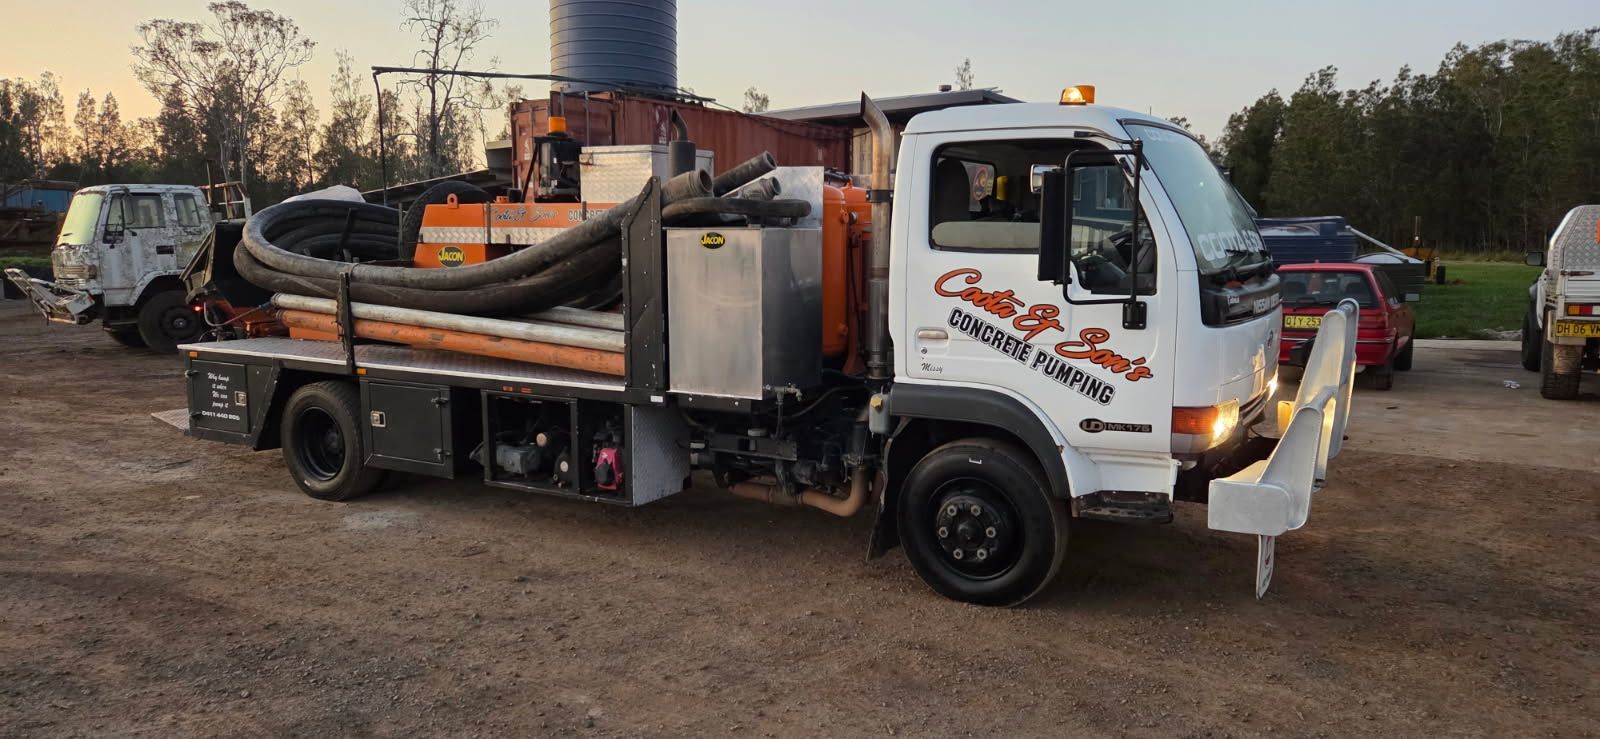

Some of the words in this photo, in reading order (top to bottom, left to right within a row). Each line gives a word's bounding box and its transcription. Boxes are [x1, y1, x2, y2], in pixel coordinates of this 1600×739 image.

[702, 233, 723, 245] JACON
[439, 247, 464, 262] JACON
[934, 268, 1025, 318] Coota
[1012, 304, 1065, 341] &
[1055, 328, 1154, 381] Son's
[1557, 324, 1570, 334] DH
[948, 307, 1034, 363] CONCRETE
[1030, 350, 1116, 406] PUMPING
[1081, 420, 1104, 432] UD
